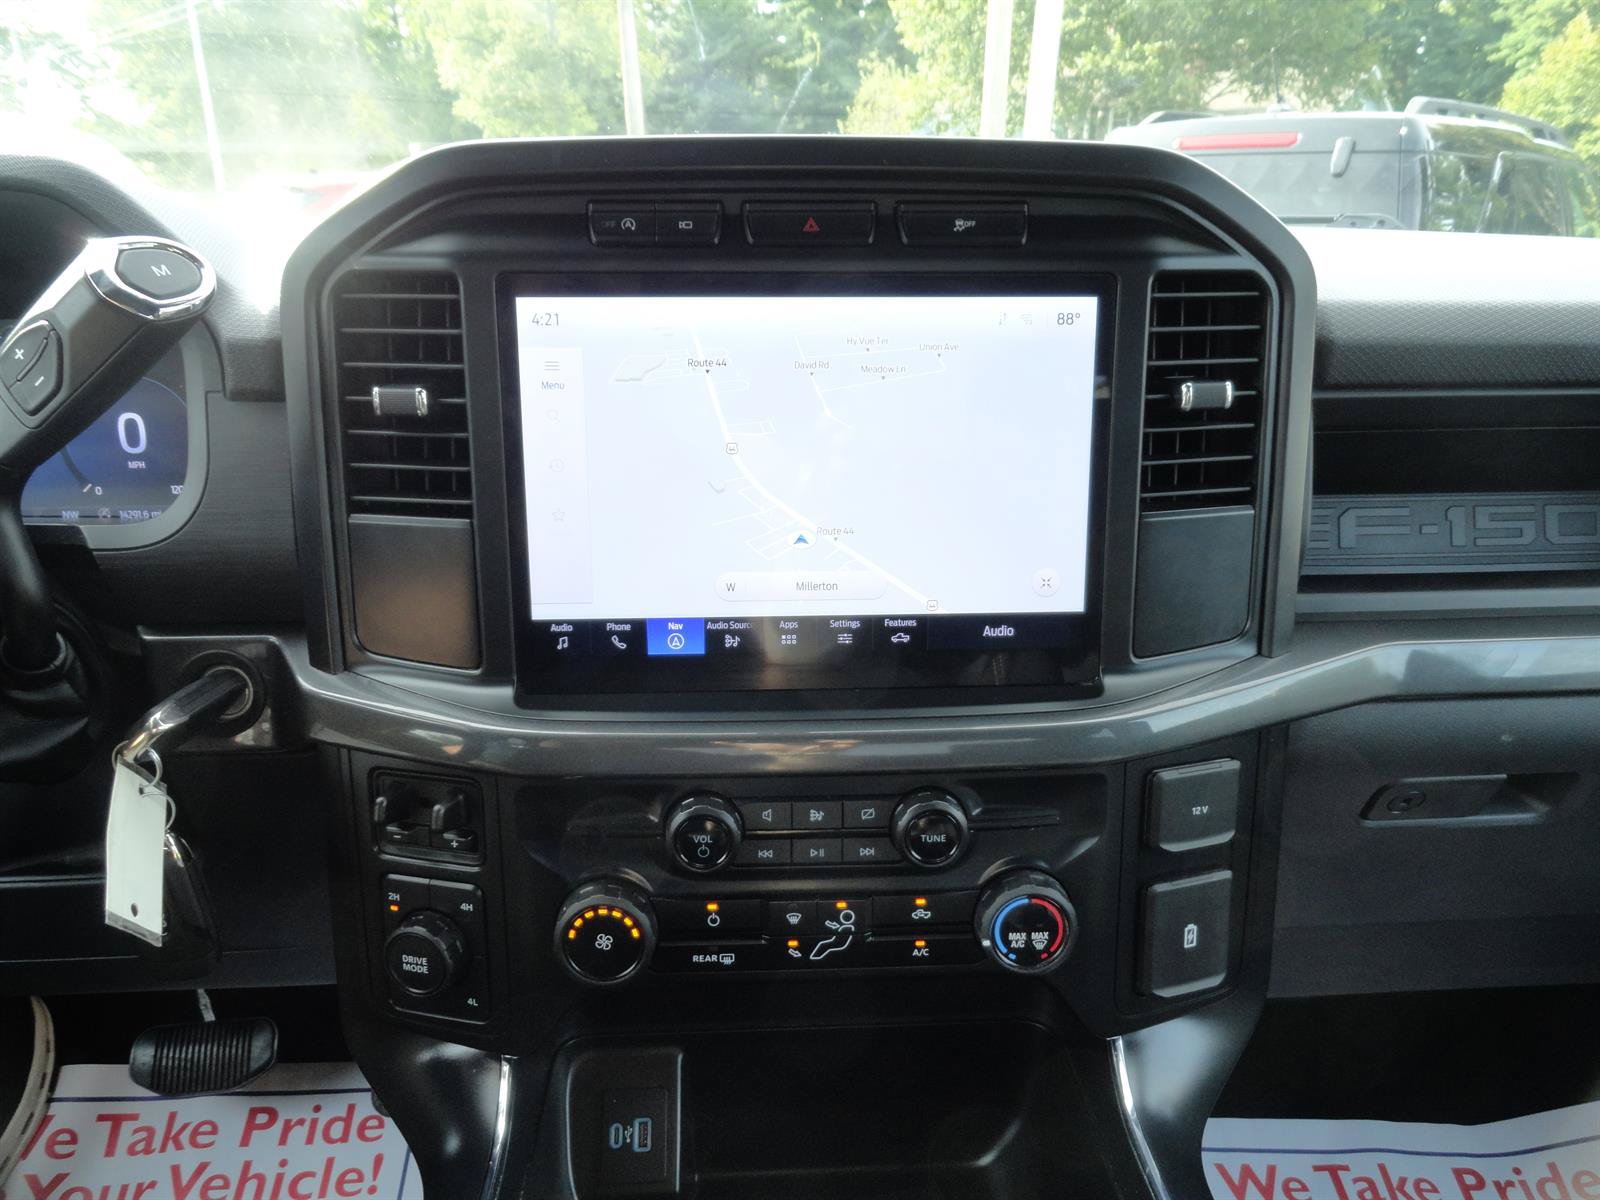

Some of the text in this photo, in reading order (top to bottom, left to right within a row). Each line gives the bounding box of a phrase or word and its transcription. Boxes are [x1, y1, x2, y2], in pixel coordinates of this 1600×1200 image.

[964, 220, 976, 228] OFF
[151, 264, 171, 277] M
[531, 312, 560, 327] 4:21
[919, 342, 959, 351] Union Ave
[687, 358, 727, 368] Route 44
[794, 360, 830, 370] David Rd
[861, 364, 906, 374] Meadow Ln
[541, 380, 565, 391] Menu
[117, 412, 147, 455] 0
[127, 460, 146, 469] MPH
[95, 486, 103, 496] 0
[817, 527, 855, 536] Route 44
[1338, 504, 1600, 550] F-150
[726, 582, 736, 592] W
[796, 581, 838, 592] Millerton
[550, 623, 574, 632] Audio
[606, 622, 632, 632] Phone
[668, 622, 684, 631] Nav
[707, 621, 728, 630] Audio
[779, 620, 799, 630] Apps
[829, 619, 861, 629] Settings
[884, 618, 917, 628] Features
[983, 625, 1015, 638] Audio
[693, 835, 713, 844] VOL
[920, 834, 947, 844] TUNE
[388, 892, 400, 901] 2H
[460, 902, 473, 911] 4H
[1008, 932, 1027, 942] MAX
[1031, 932, 1049, 941] MAX
[1010, 940, 1026, 949] A/C
[912, 948, 930, 957] A/C
[402, 954, 428, 966] DRIVE
[692, 955, 718, 964] REAR
[402, 964, 429, 974] MODE
[467, 997, 479, 1007] 4L
[96, 1111, 219, 1159] Take
[239, 1103, 385, 1148] Pride
[23, 1152, 385, 1200] Your Vehicle!
[1214, 1161, 1600, 1200] We Take Pride
